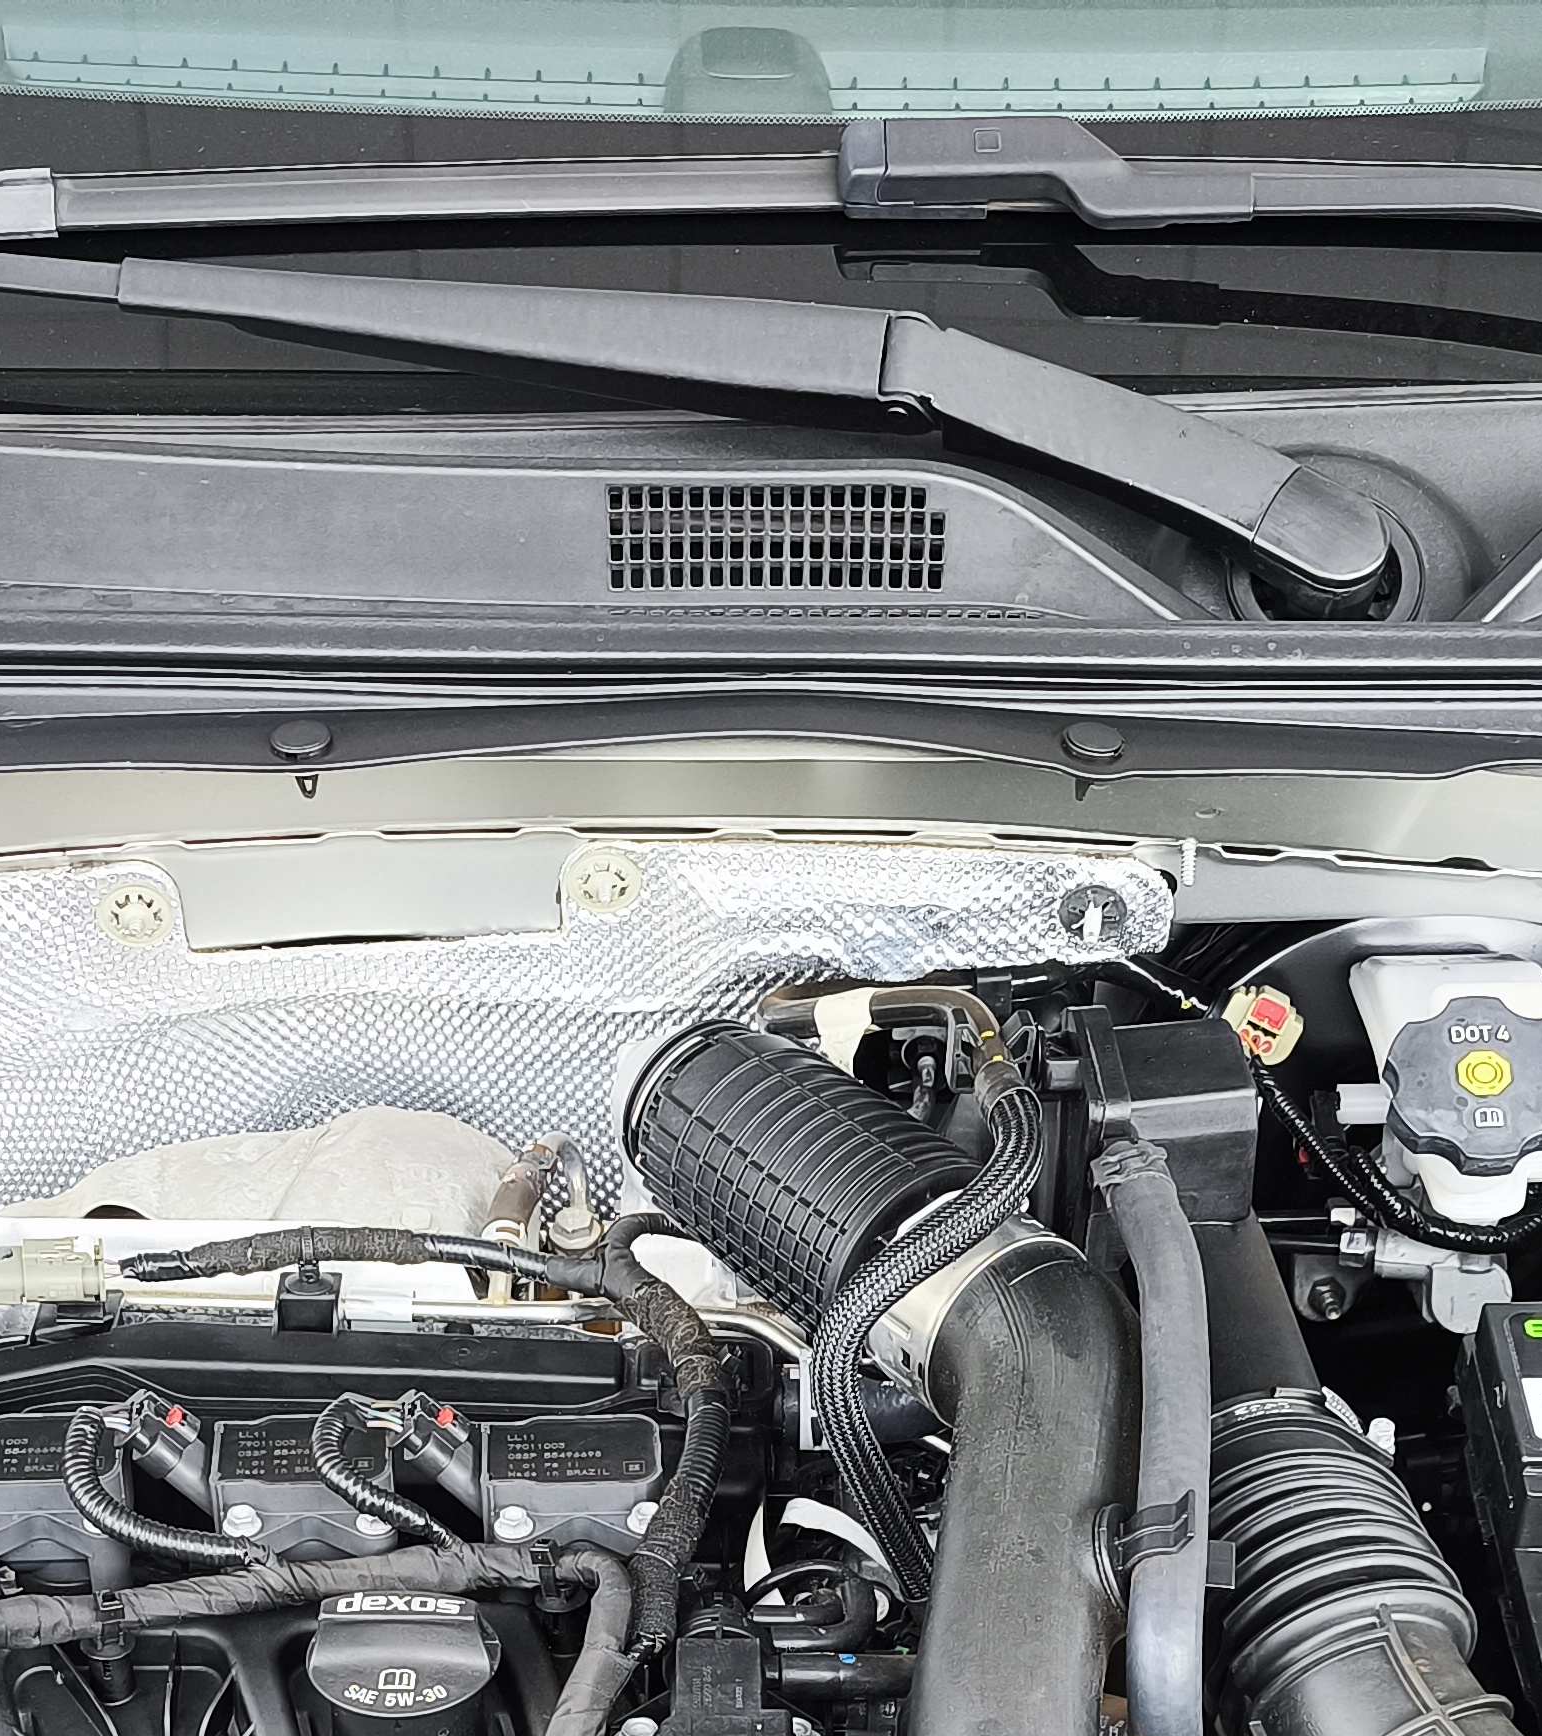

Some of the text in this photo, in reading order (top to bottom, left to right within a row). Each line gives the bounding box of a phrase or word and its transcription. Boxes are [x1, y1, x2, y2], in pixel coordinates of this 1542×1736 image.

[1450, 1024, 1510, 1043] DOT 4
[23, 1464, 64, 1472] BRAZI
[337, 1592, 466, 1614] dexos
[343, 1684, 448, 1707] SAE 5W-30
